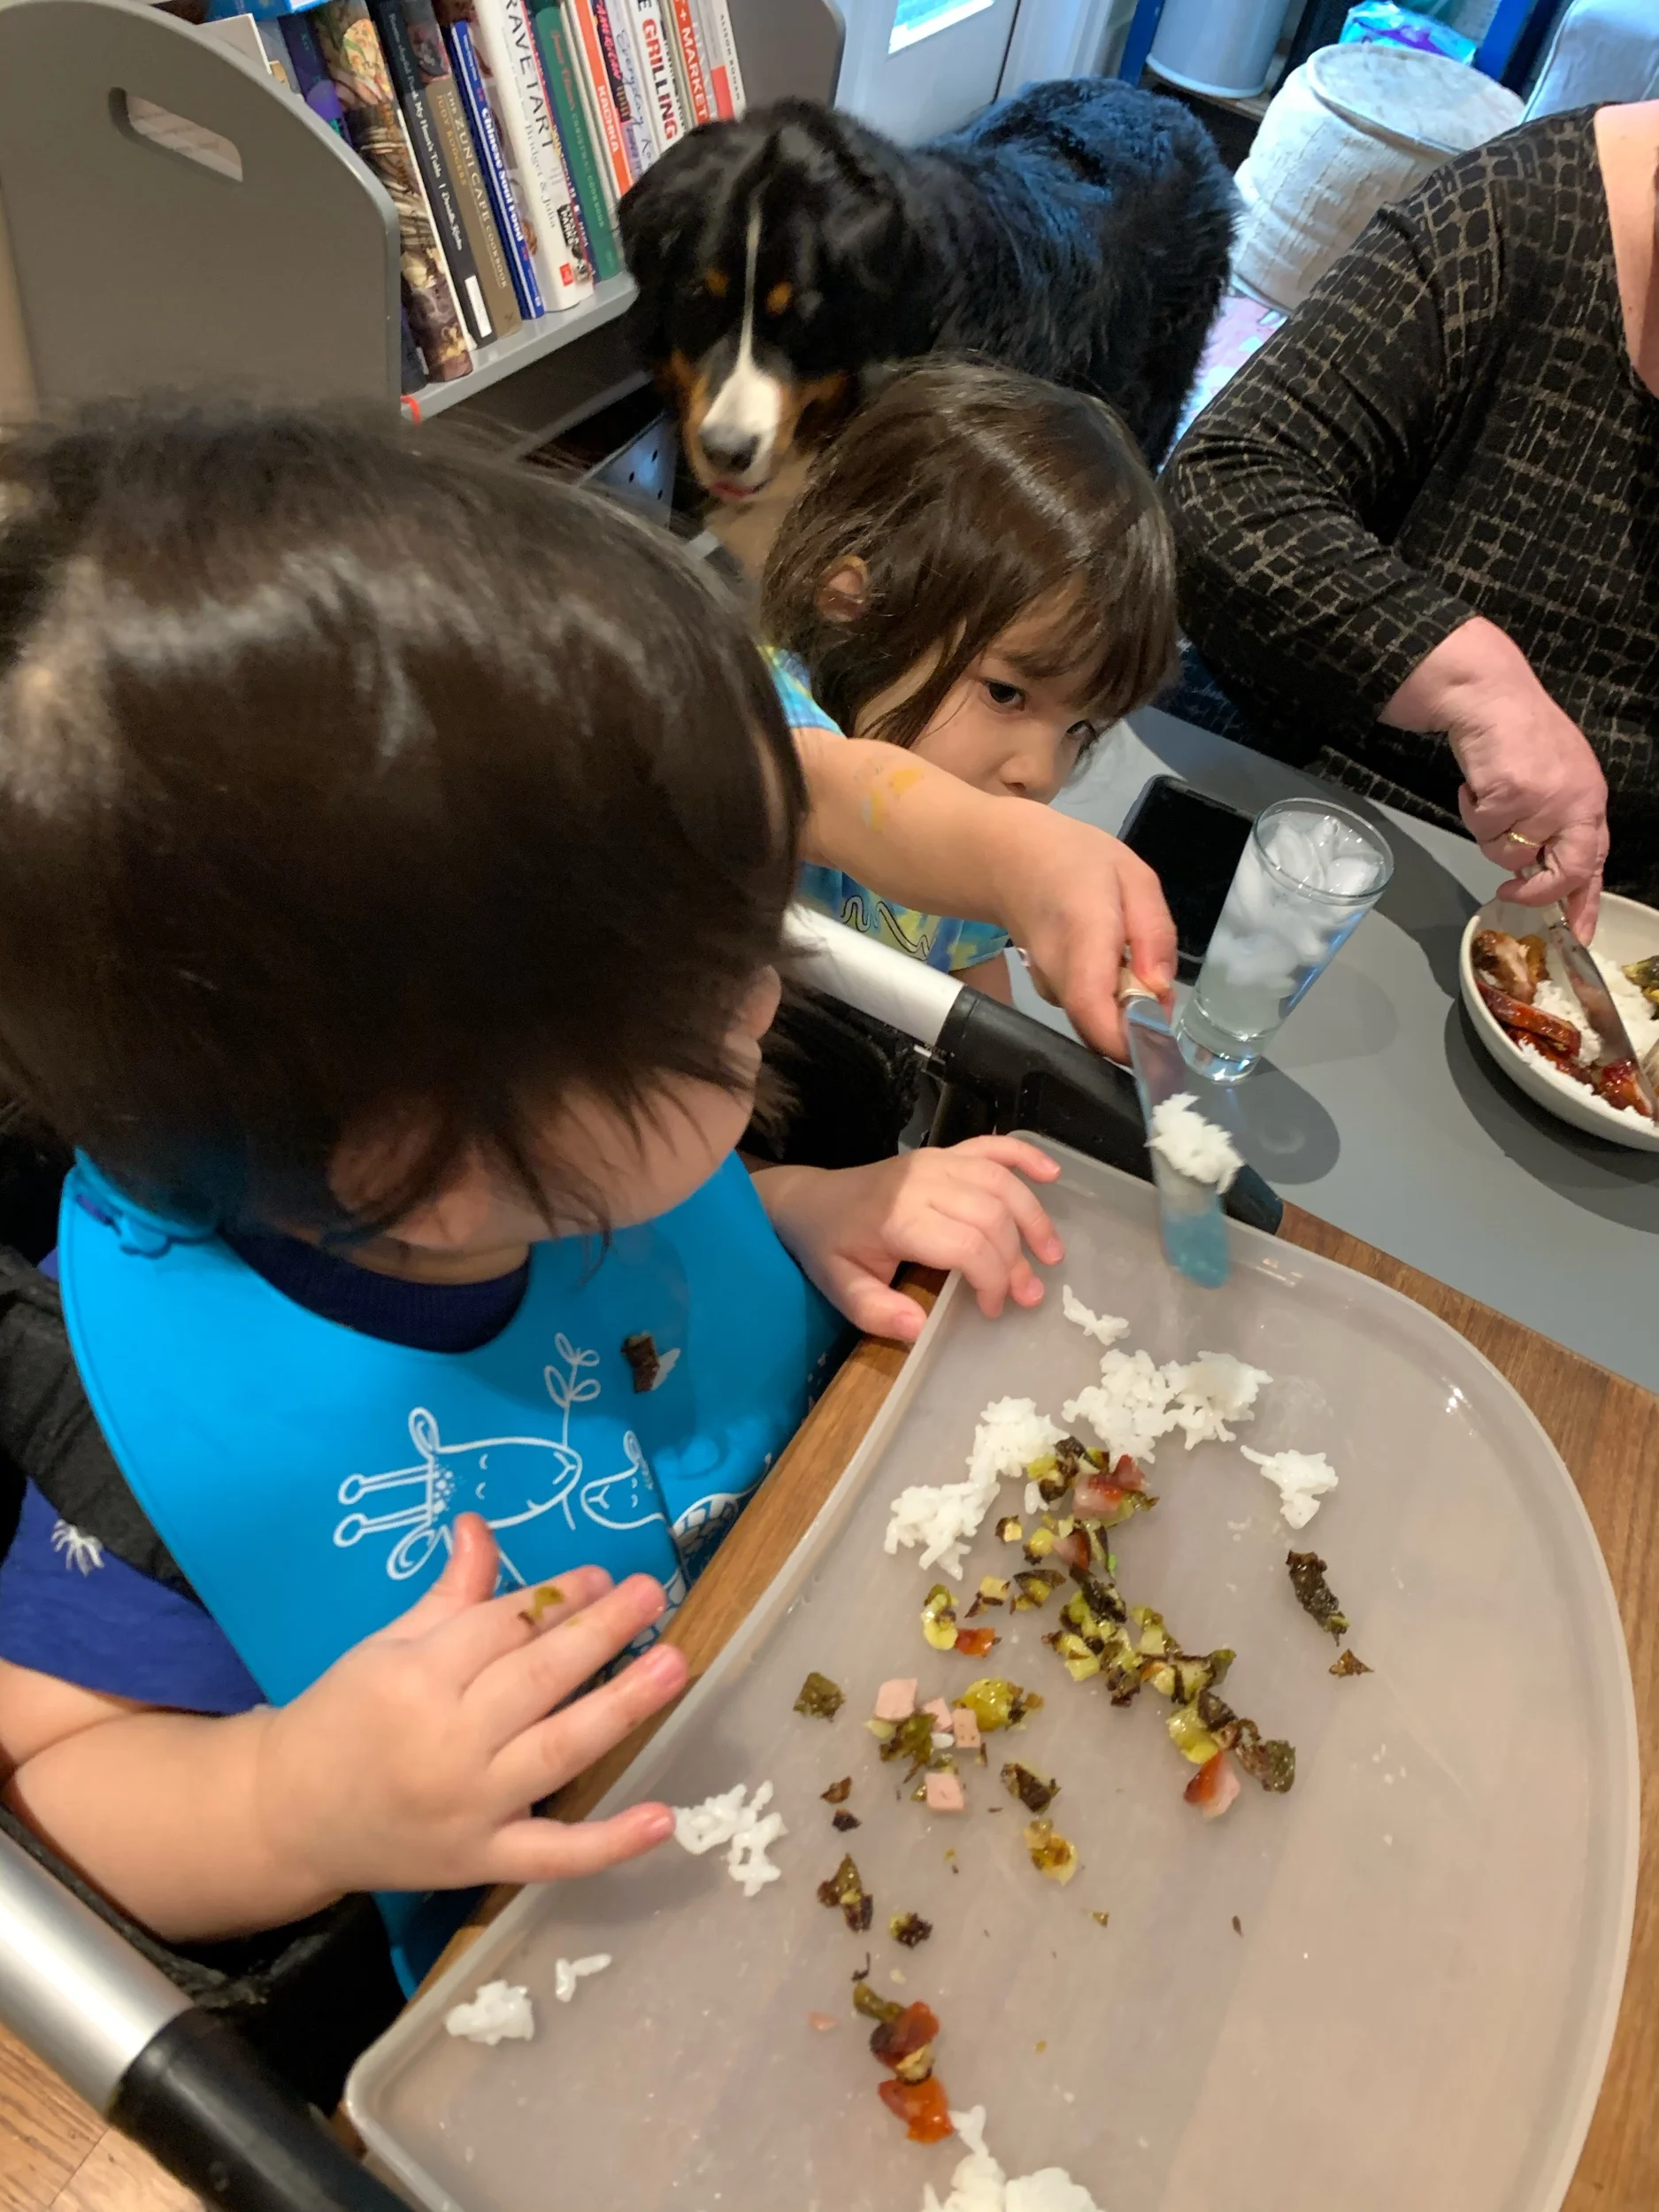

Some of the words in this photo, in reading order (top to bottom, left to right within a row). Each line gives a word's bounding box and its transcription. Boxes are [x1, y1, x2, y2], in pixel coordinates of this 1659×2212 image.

[616, 28, 645, 127] Everyday
[642, 18, 678, 140] GRILLING
[680, 27, 709, 121] MARKET
[719, 13, 732, 56] ALISON
[413, 101, 424, 119] My
[436, 94, 449, 125] JUDY
[445, 130, 467, 187] RODGERS
[596, 84, 619, 154] KACHKA
[447, 90, 458, 114] THE
[454, 116, 476, 167] ZUNI
[486, 225, 508, 288] COOKBOOK
[480, 107, 503, 169] Chinese
[498, 170, 514, 204] Soul
[508, 204, 524, 242] Food
[525, 124, 543, 177] Bridget
[541, 197, 557, 229] Julia
[560, 210, 574, 244] PARKS
